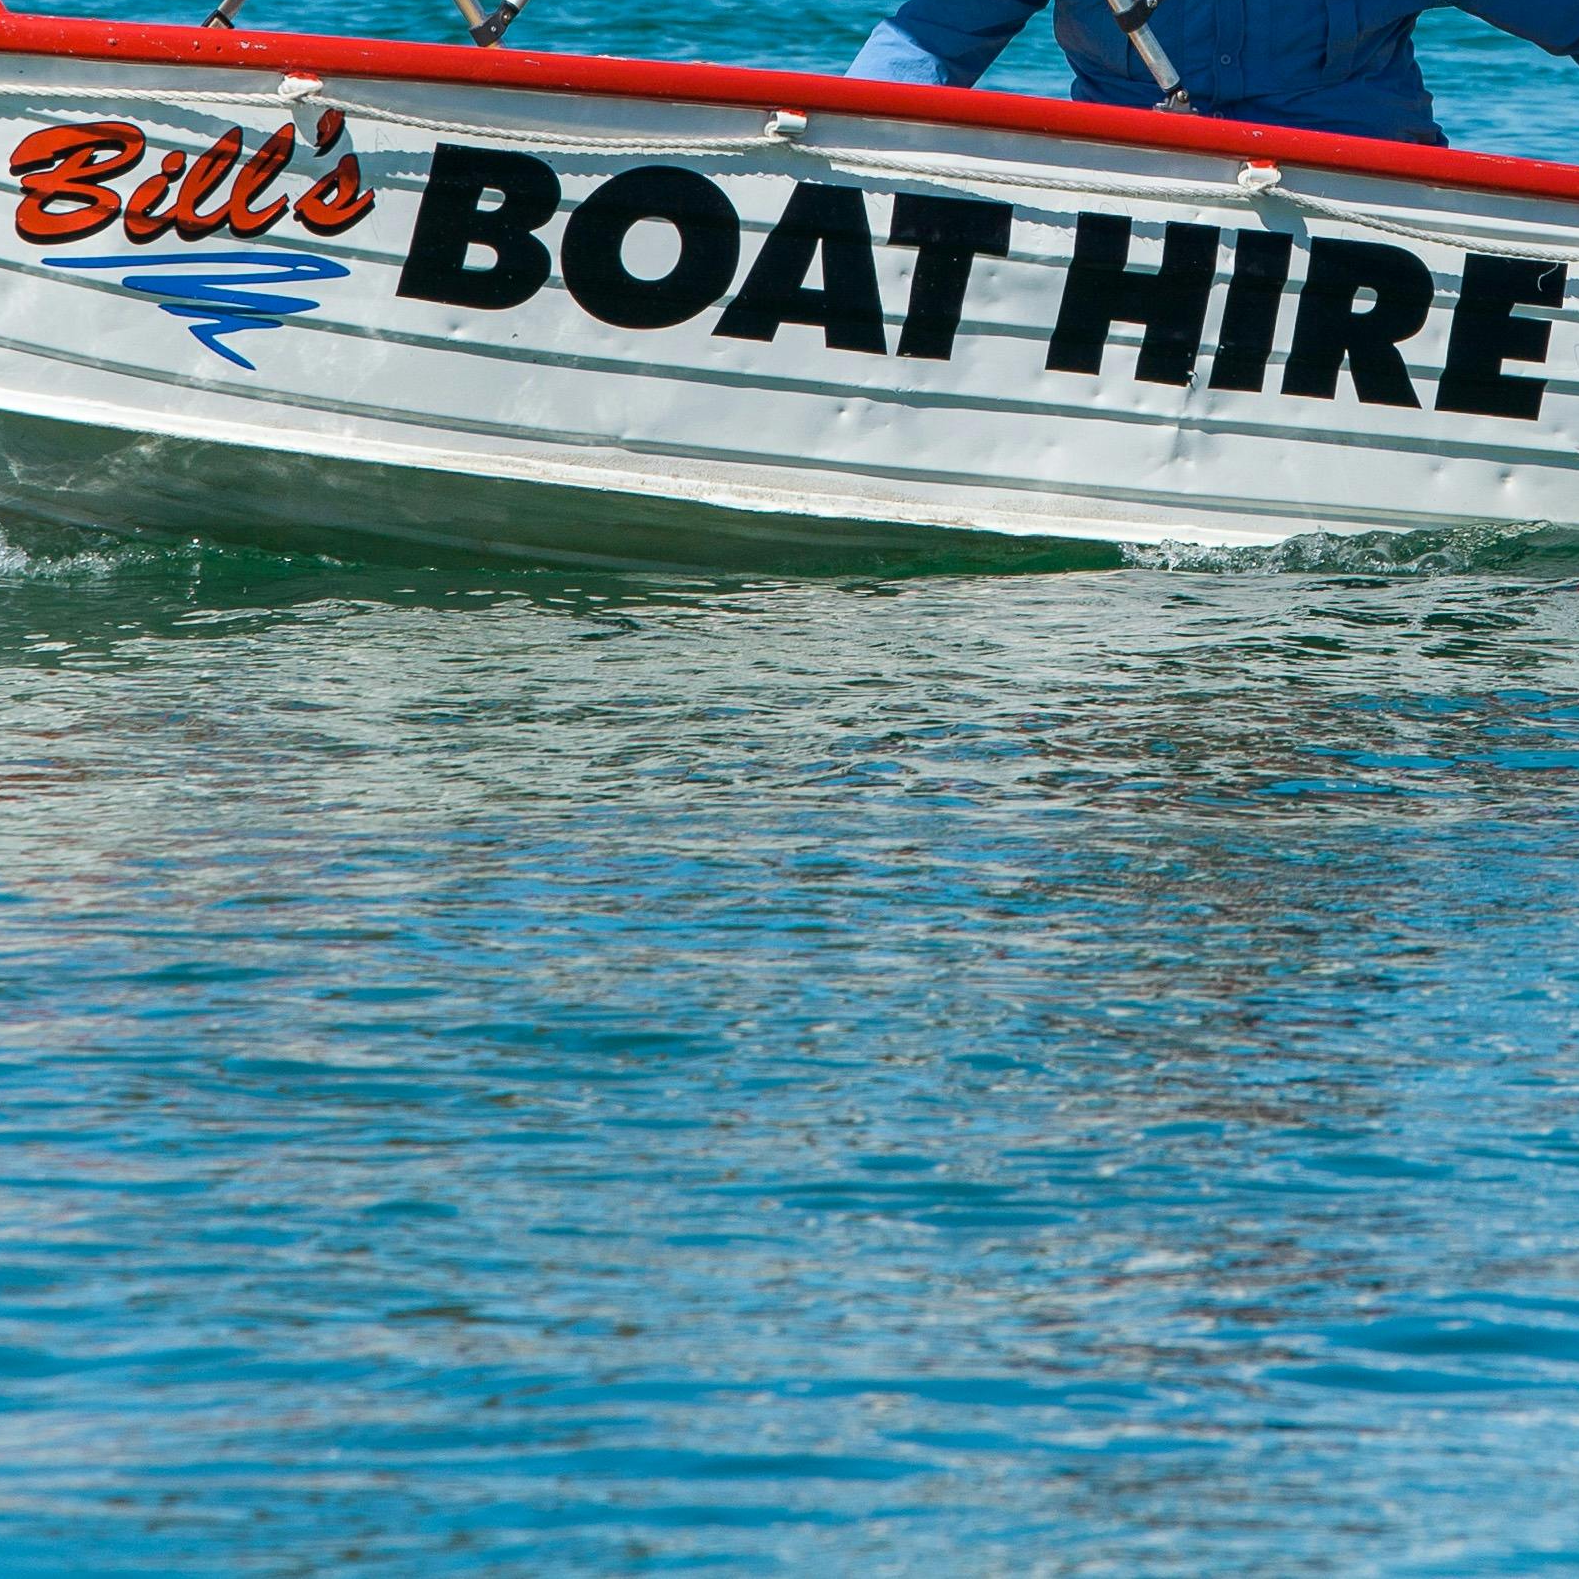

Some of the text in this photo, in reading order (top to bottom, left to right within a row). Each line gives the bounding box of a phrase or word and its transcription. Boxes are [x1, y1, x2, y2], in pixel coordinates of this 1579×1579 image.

[10, 110, 1568, 421] Bill's BOAT HIRE
